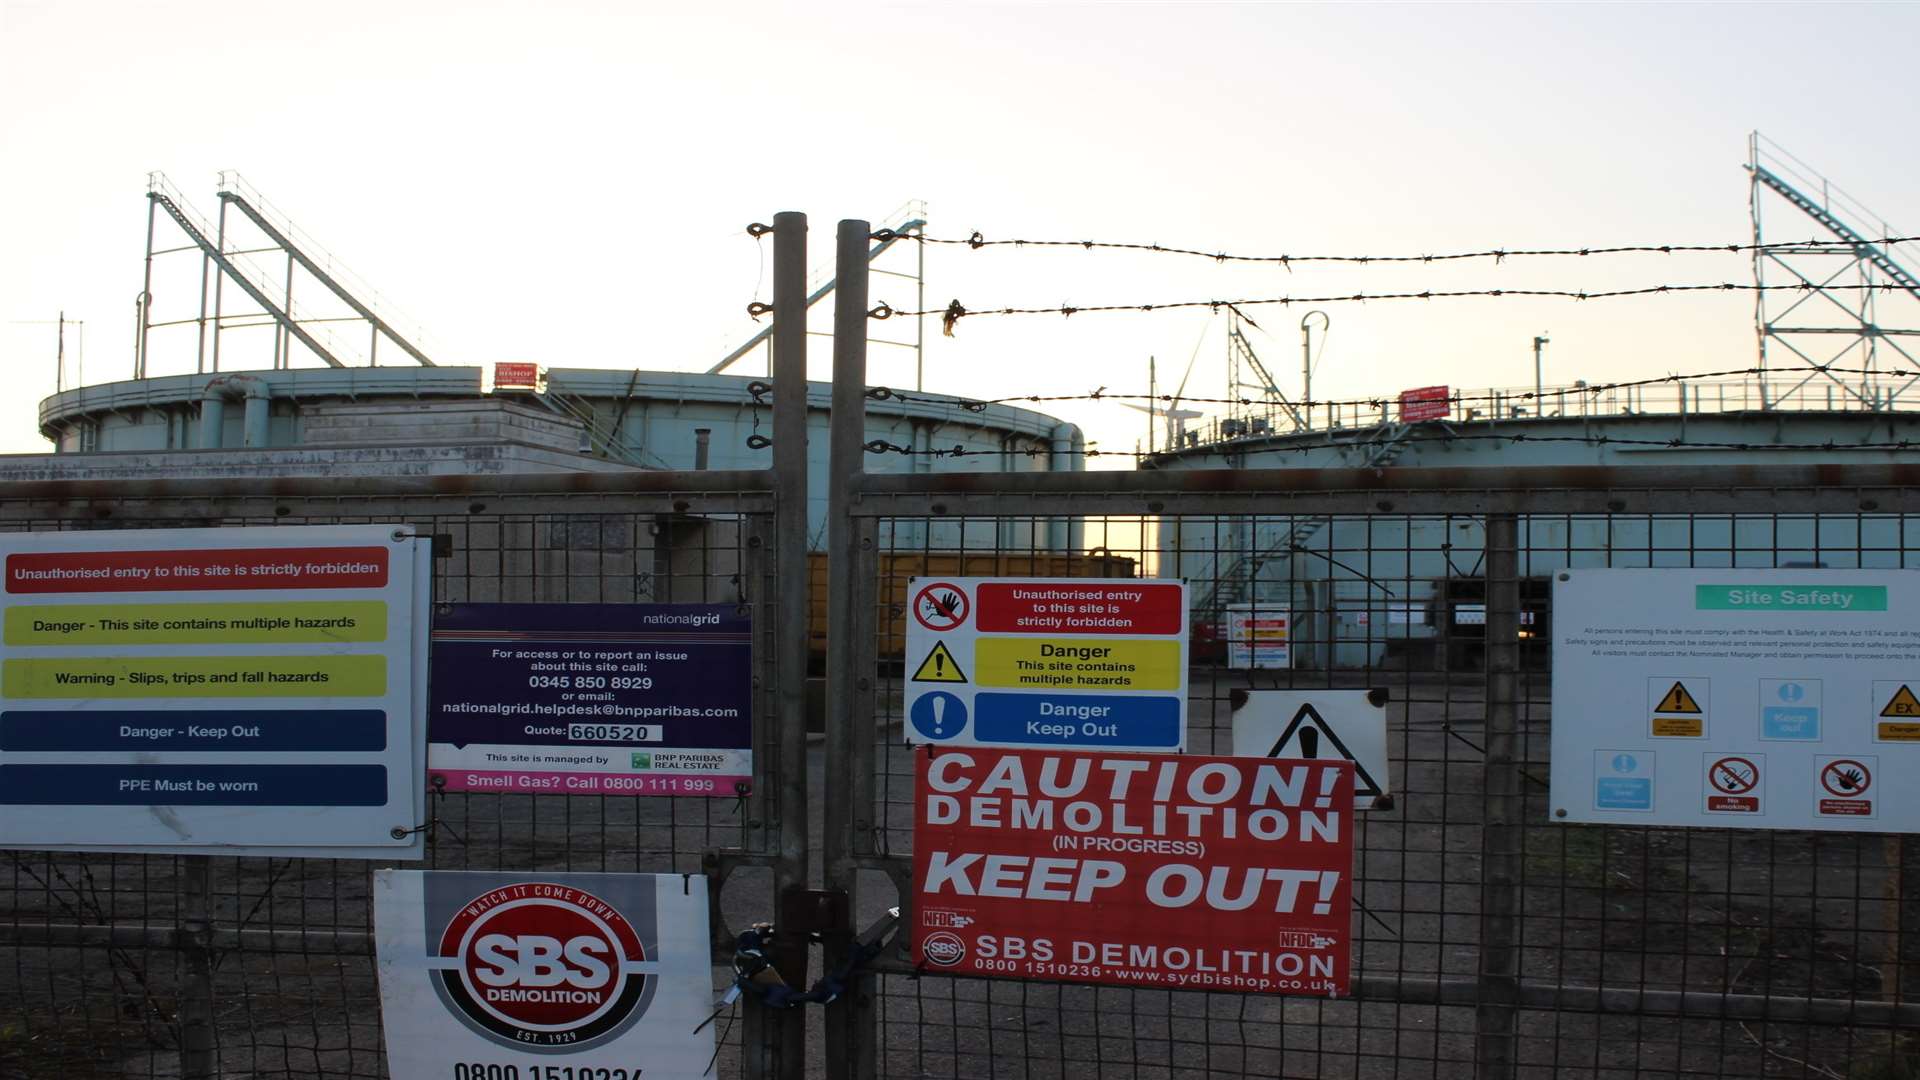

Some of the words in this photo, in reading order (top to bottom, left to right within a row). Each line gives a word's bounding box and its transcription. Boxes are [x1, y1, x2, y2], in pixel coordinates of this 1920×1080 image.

[15, 566, 110, 580] Unauthorised
[114, 566, 150, 580] entry
[154, 565, 170, 576] to
[174, 564, 199, 576] this
[204, 563, 230, 576] site
[235, 563, 247, 575] is
[251, 562, 301, 577] strictly
[305, 561, 378, 574] forbidden
[1013, 590, 1103, 600] Unauthorised
[1107, 592, 1142, 602] entry
[1729, 590, 1771, 605] Site
[1780, 591, 1853, 608] Safety
[1033, 604, 1046, 613] to
[1050, 604, 1075, 613] this
[1079, 604, 1104, 613] site
[1108, 604, 1119, 614] is
[33, 620, 85, 633] Danger
[99, 618, 130, 631] This
[133, 618, 159, 630] site
[163, 617, 226, 630] contains
[231, 616, 290, 631] multiple
[295, 616, 355, 628] hazards
[644, 614, 720, 626] nationalgrid
[1017, 618, 1062, 628] strictly
[1067, 618, 1132, 627] forbidden
[492, 649, 512, 658] For
[515, 651, 558, 659] access
[562, 651, 576, 659] or
[579, 651, 591, 659] to
[595, 650, 632, 661] report
[655, 651, 687, 660] issue
[1041, 644, 1111, 661] Danger
[531, 662, 565, 671] about
[569, 662, 592, 671] this
[596, 662, 619, 671] site
[621, 663, 647, 672] call:
[1017, 661, 1044, 670] This
[1049, 661, 1072, 671] site
[1077, 662, 1135, 672] contains
[56, 672, 115, 686] Warning
[129, 671, 169, 686] Slips,
[173, 671, 205, 686] trips
[209, 671, 238, 683] and
[242, 670, 263, 683] fall
[268, 670, 328, 683] hazards
[529, 676, 569, 688] 0345
[575, 677, 605, 689] 850
[611, 677, 652, 689] 8929
[1020, 674, 1073, 686] multiple
[1077, 675, 1131, 686] hazards
[579, 692, 615, 700] email:
[443, 703, 737, 719] nationalgrid.helpdesk@bnpparibas.com
[1040, 703, 1110, 719] Danger
[1896, 703, 1913, 713] EX
[120, 725, 173, 739] Danger
[188, 725, 227, 740] Keep
[232, 725, 259, 737] Out
[525, 725, 566, 737] Quote:
[571, 726, 648, 740] 660520
[1027, 721, 1076, 738] Keep
[1082, 723, 1118, 736] Out
[487, 754, 508, 762] This
[511, 754, 530, 763] site
[533, 755, 541, 763] is
[544, 755, 593, 765] managed
[596, 755, 608, 765] by
[655, 754, 676, 762] BNP
[679, 754, 724, 763] PARIBAS
[691, 762, 720, 770] ESTATE
[120, 779, 150, 792] PPE
[155, 779, 191, 792] Must
[197, 779, 215, 792] be
[219, 781, 258, 792] worn
[467, 775, 512, 787] Smell
[518, 776, 560, 788] Gas?
[566, 776, 598, 789] Call
[603, 777, 643, 789] 0800
[649, 779, 676, 790] 111
[684, 779, 714, 790] 999
[927, 753, 1343, 808] CAUTION!
[927, 795, 1339, 843] DEMOLITION
[1052, 835, 1078, 852] (IN
[1083, 836, 1206, 859] PROGRESS)
[923, 851, 1125, 903] KEEP
[1145, 864, 1340, 915] OUT!
[514, 886, 527, 897] IT
[534, 886, 572, 900] COME
[930, 942, 958, 955] SBS
[475, 933, 611, 989] SBS
[976, 935, 1054, 961] SBS
[1073, 941, 1334, 978] DEMOLITION
[975, 959, 1016, 971] 0800
[1026, 961, 1101, 977] 1510236
[1116, 968, 1336, 990] www.sydbishop.co.uk
[487, 989, 600, 1004] DEMOLITION
[517, 1030, 542, 1043] EST.
[550, 1031, 577, 1044] 1929
